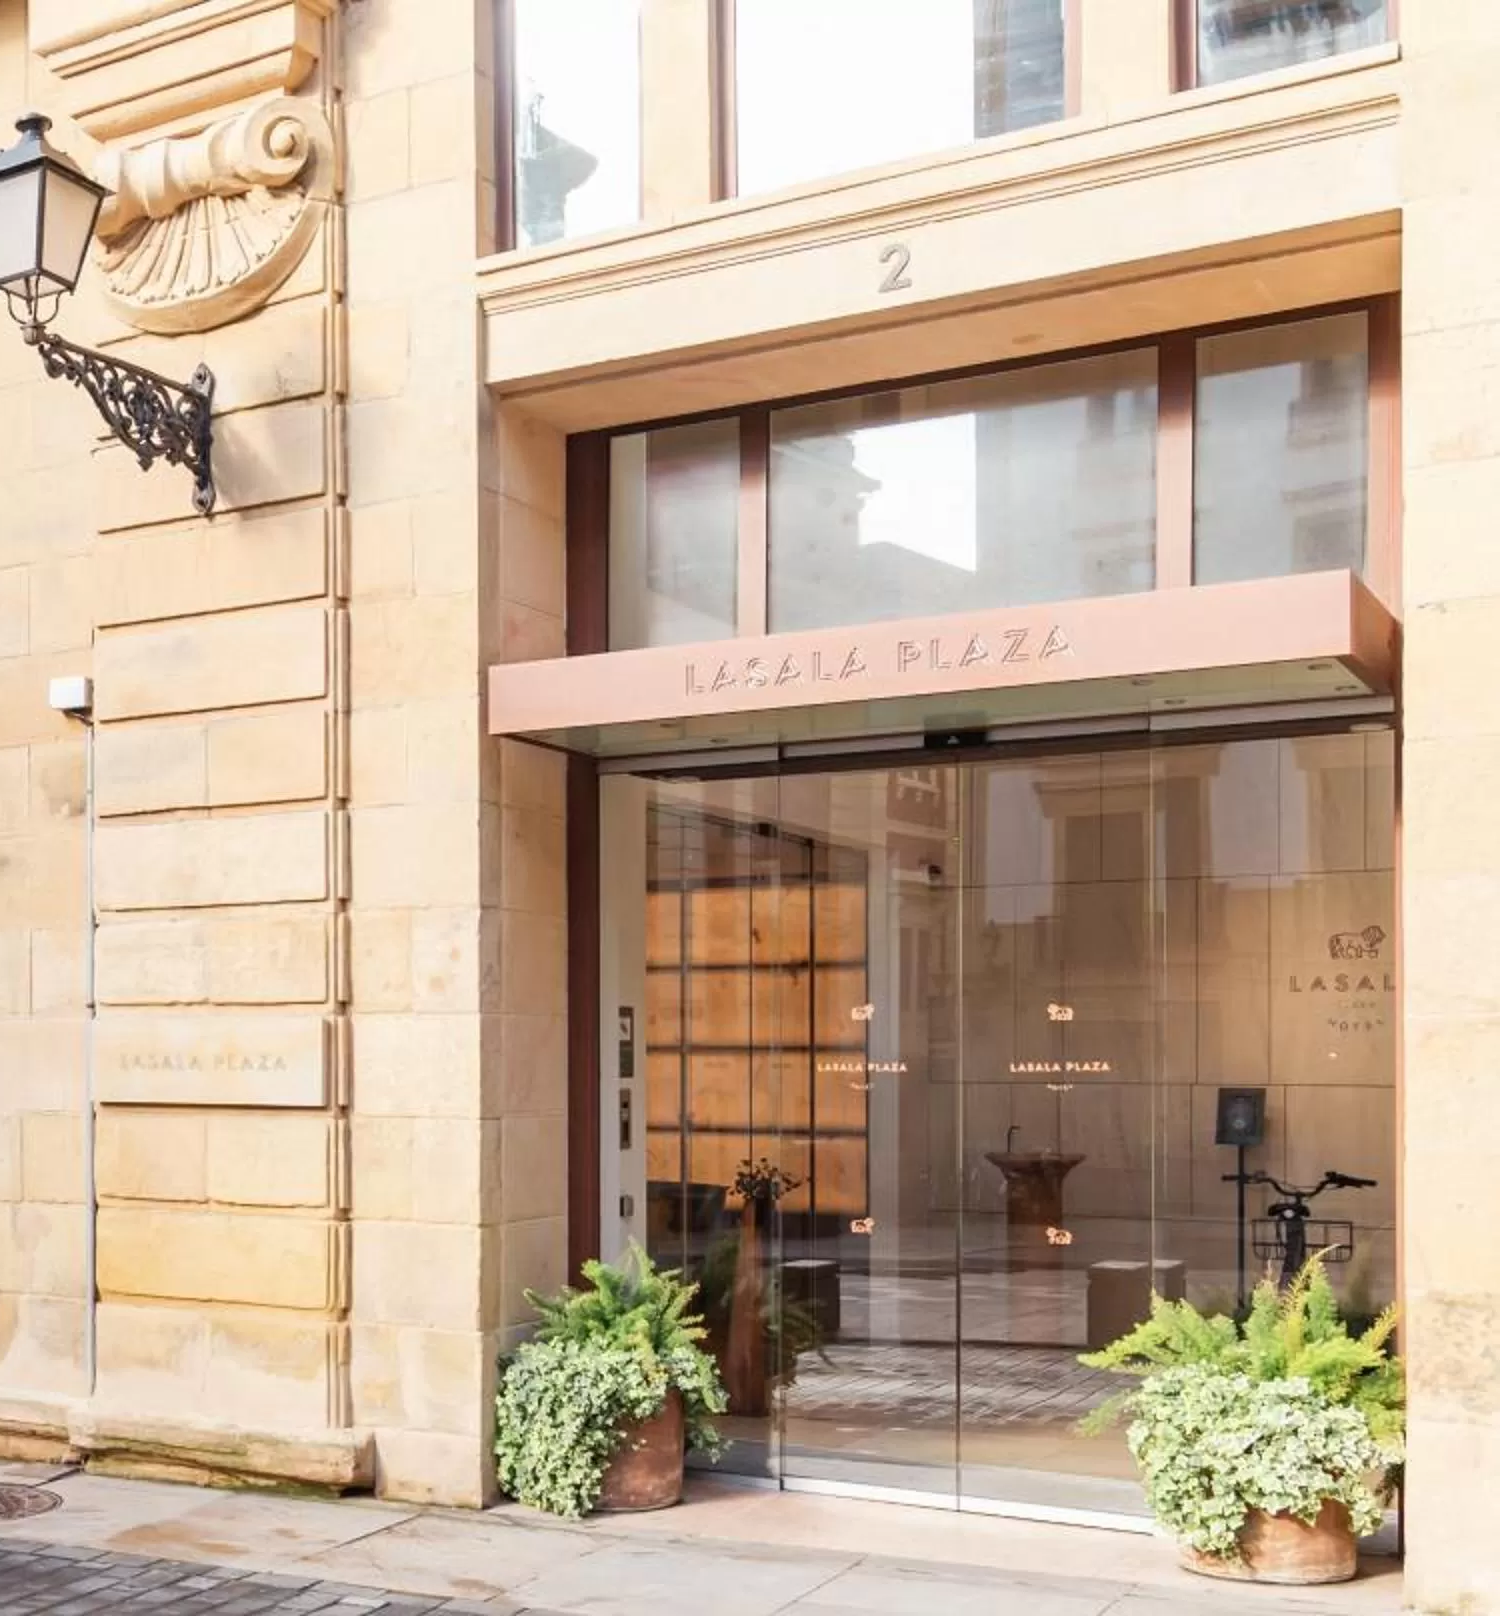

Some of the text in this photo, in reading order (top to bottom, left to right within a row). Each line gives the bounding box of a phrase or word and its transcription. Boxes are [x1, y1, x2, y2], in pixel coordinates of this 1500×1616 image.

[878, 243, 912, 293] 2
[685, 624, 1074, 697] LASALA PLAZA
[119, 1054, 287, 1072] LASALA PLAZA
[817, 1062, 908, 1073] LASALA PLAZA
[1009, 1061, 1110, 1073] LASALA PLAZA
